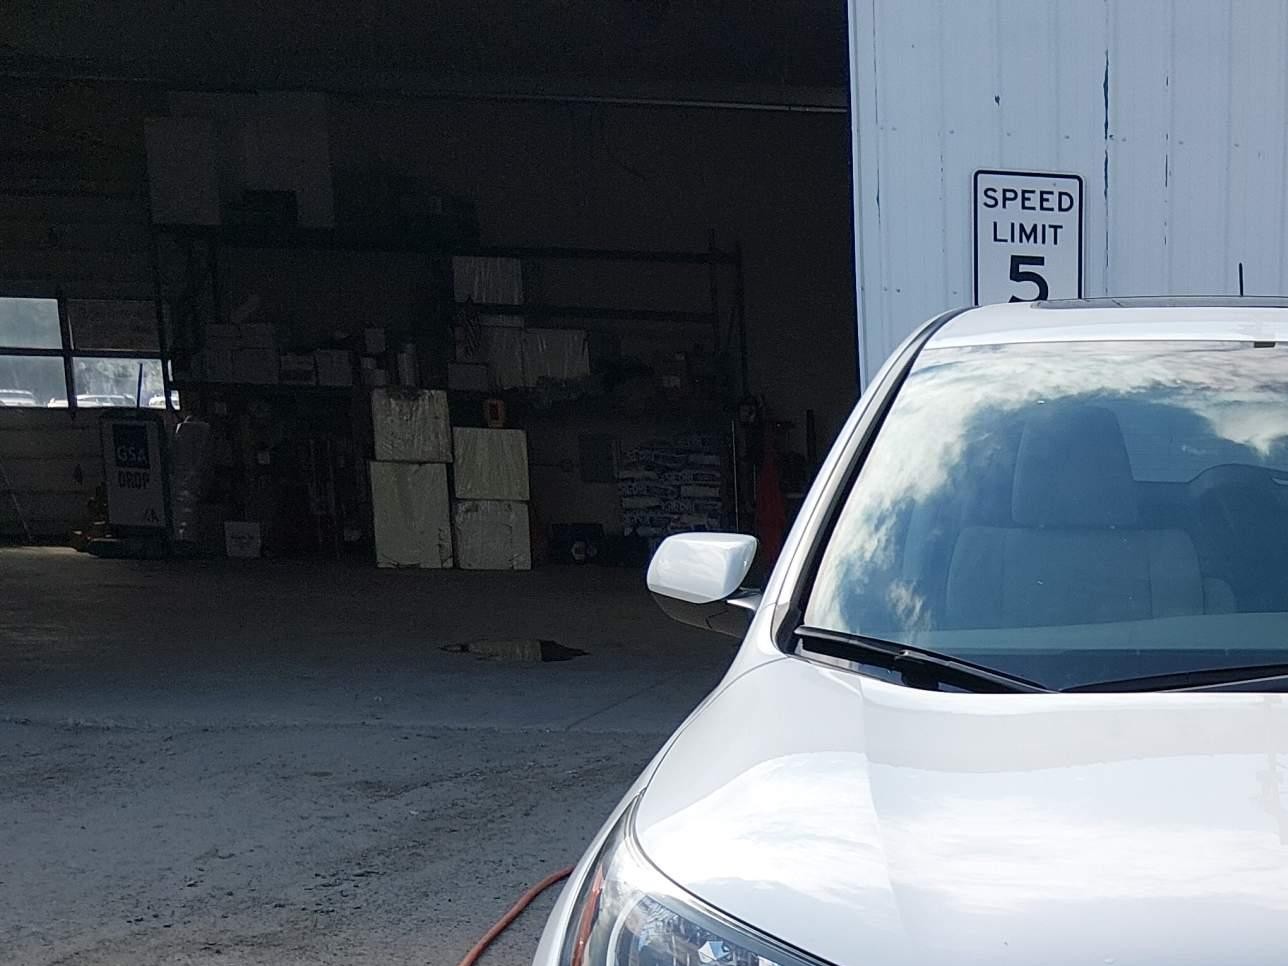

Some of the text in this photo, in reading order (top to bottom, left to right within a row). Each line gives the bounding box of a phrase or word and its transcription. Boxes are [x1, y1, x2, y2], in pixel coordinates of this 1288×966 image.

[983, 187, 1074, 212] SPEED
[993, 221, 1063, 245] LIMIT
[1008, 255, 1049, 303] 5
